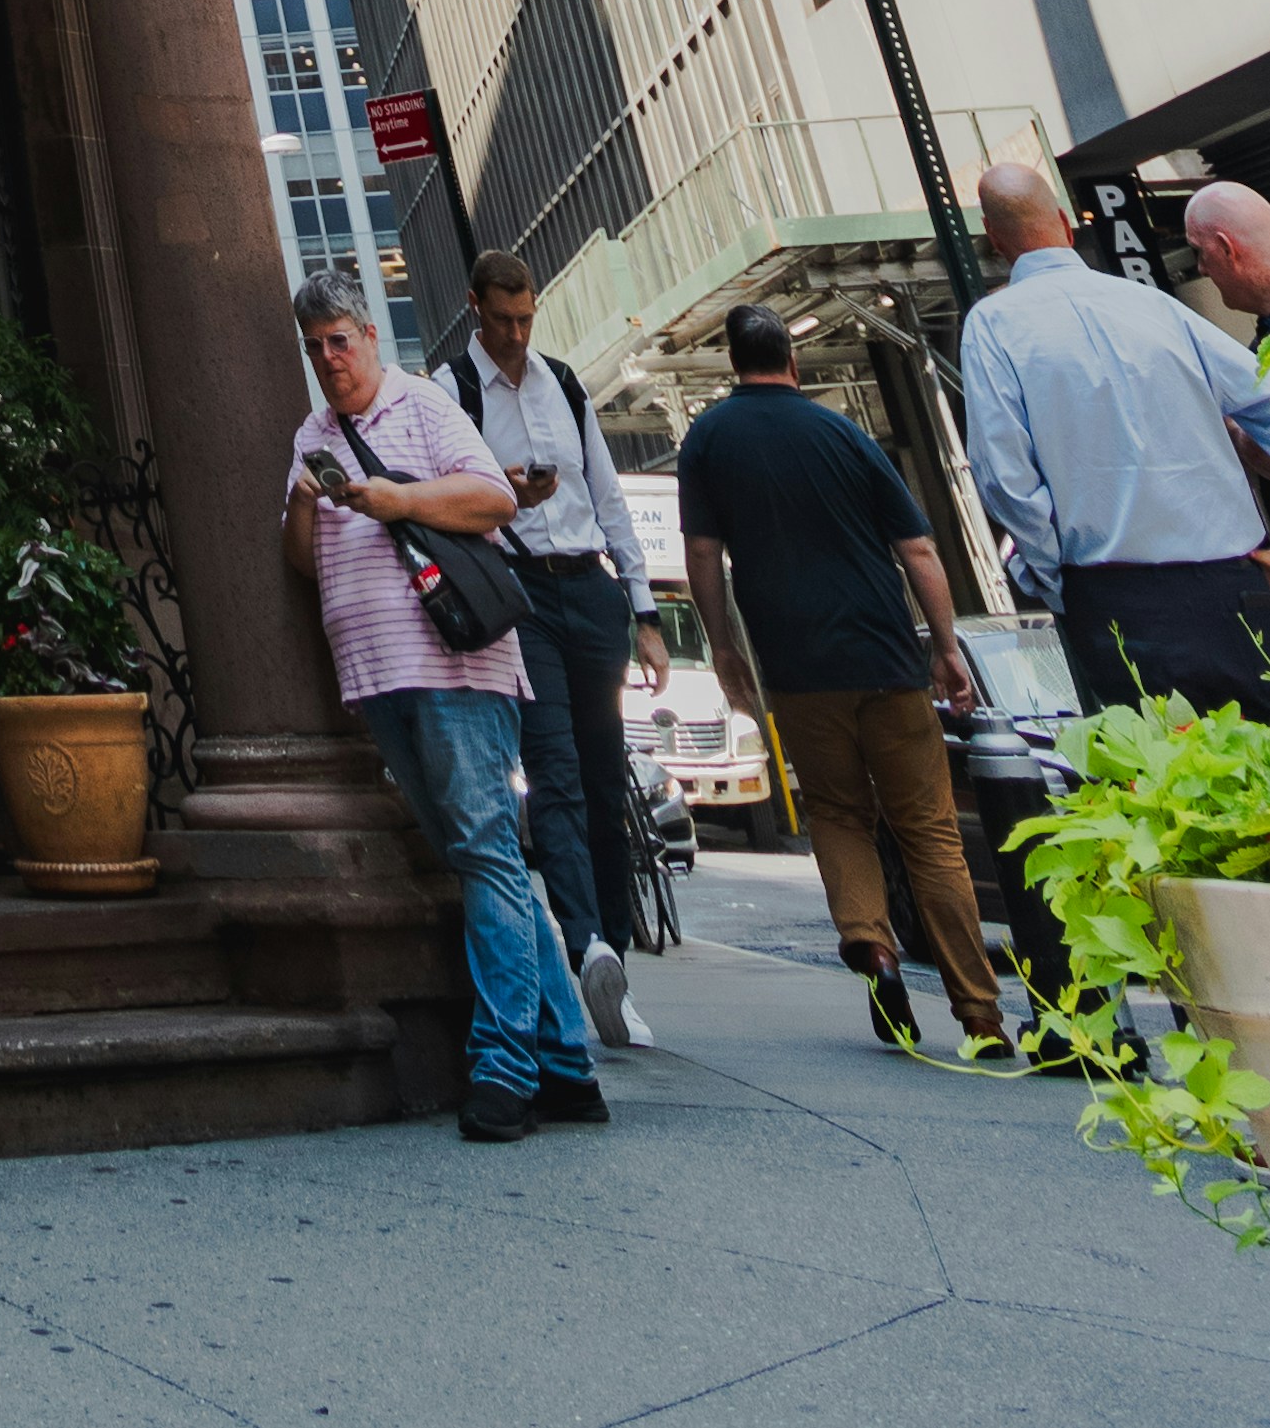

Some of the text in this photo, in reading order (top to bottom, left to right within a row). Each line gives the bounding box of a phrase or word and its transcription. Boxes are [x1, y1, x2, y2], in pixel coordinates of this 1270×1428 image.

[370, 97, 426, 117] NO STANDING
[375, 117, 409, 133] Anytime
